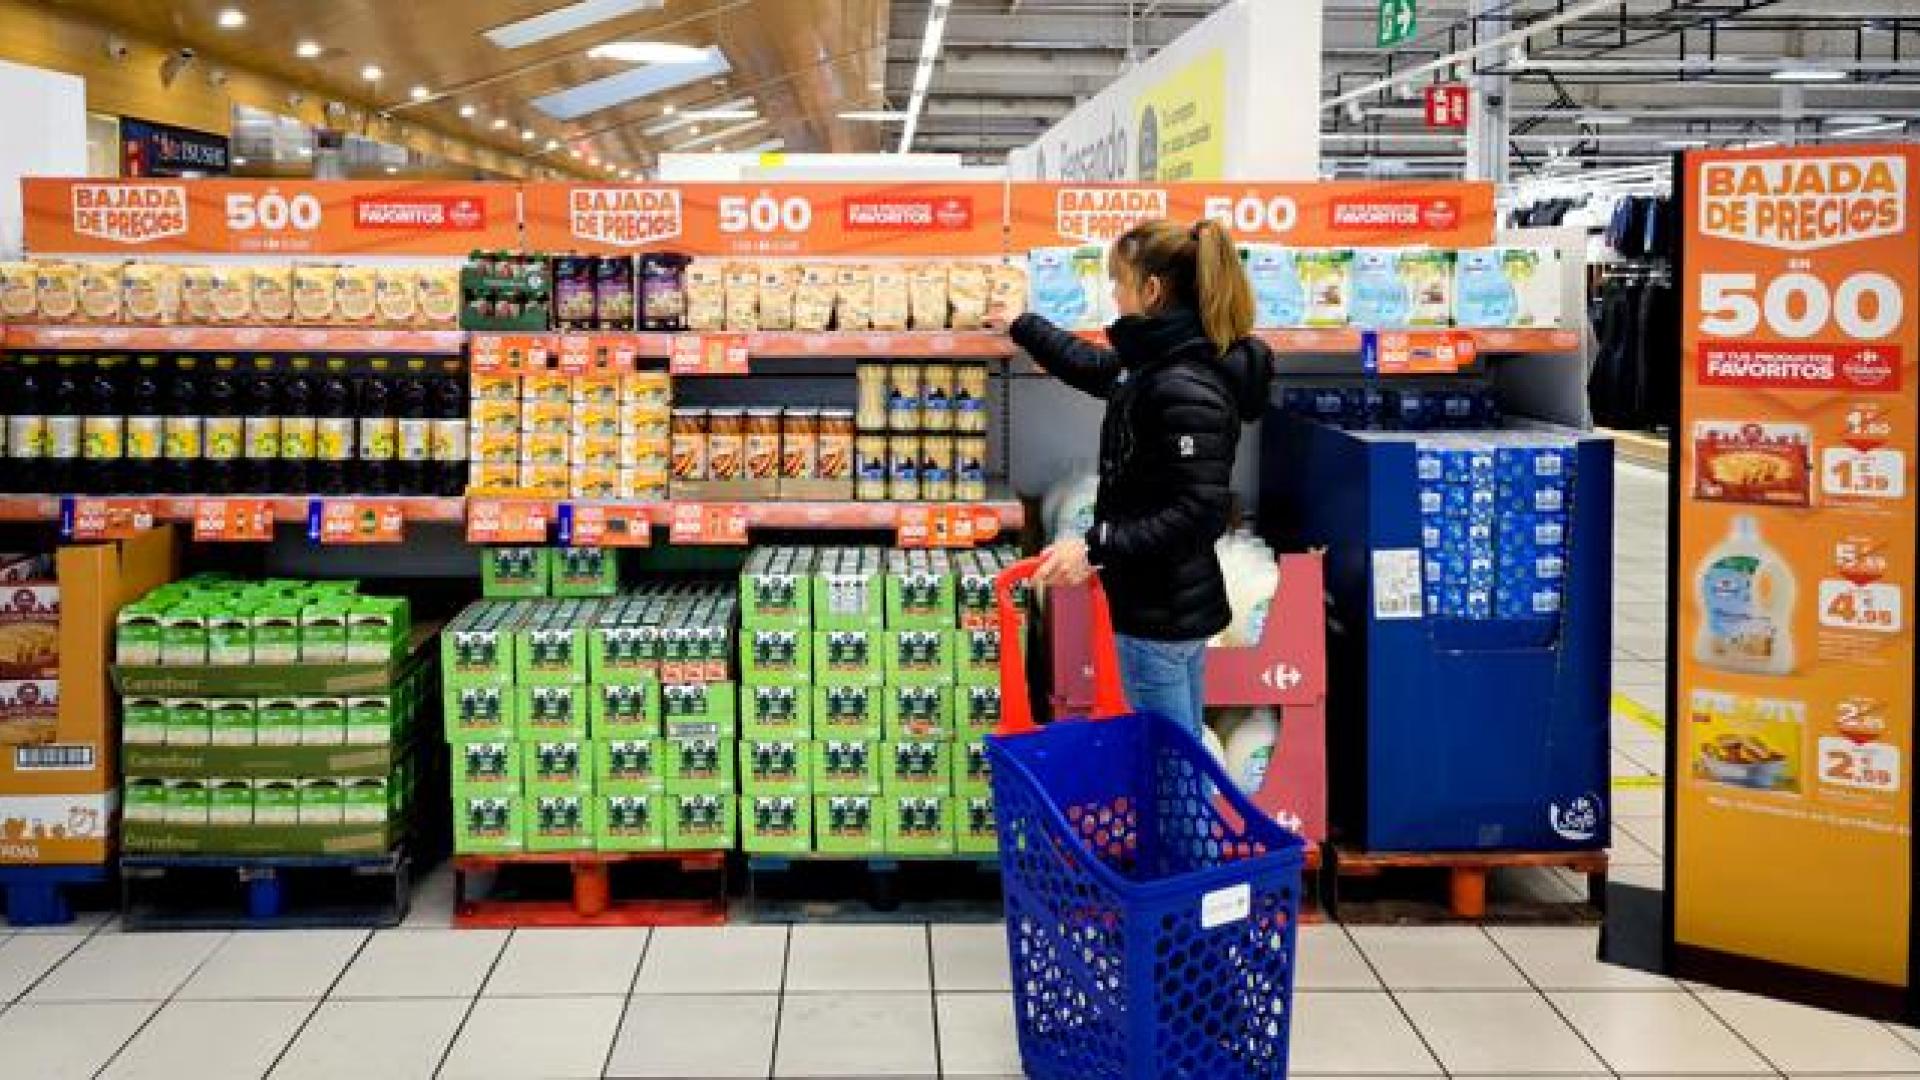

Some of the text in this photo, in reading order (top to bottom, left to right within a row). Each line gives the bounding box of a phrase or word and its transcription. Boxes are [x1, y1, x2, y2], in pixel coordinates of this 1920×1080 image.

[1707, 160, 1896, 196] BAJADA
[76, 188, 182, 208] BAJADA
[225, 193, 322, 230] 500
[575, 191, 675, 211] BAJADA
[717, 195, 813, 233] 500
[1062, 191, 1161, 211] BAJADA
[1204, 195, 1296, 232] 500
[76, 211, 183, 239] DE PRECIOS
[575, 212, 677, 241] DE PRECIOS
[1707, 198, 1898, 241] DE PRECIOS
[1698, 273, 1904, 338] 500
[1707, 361, 1834, 380] FAVORITOS
